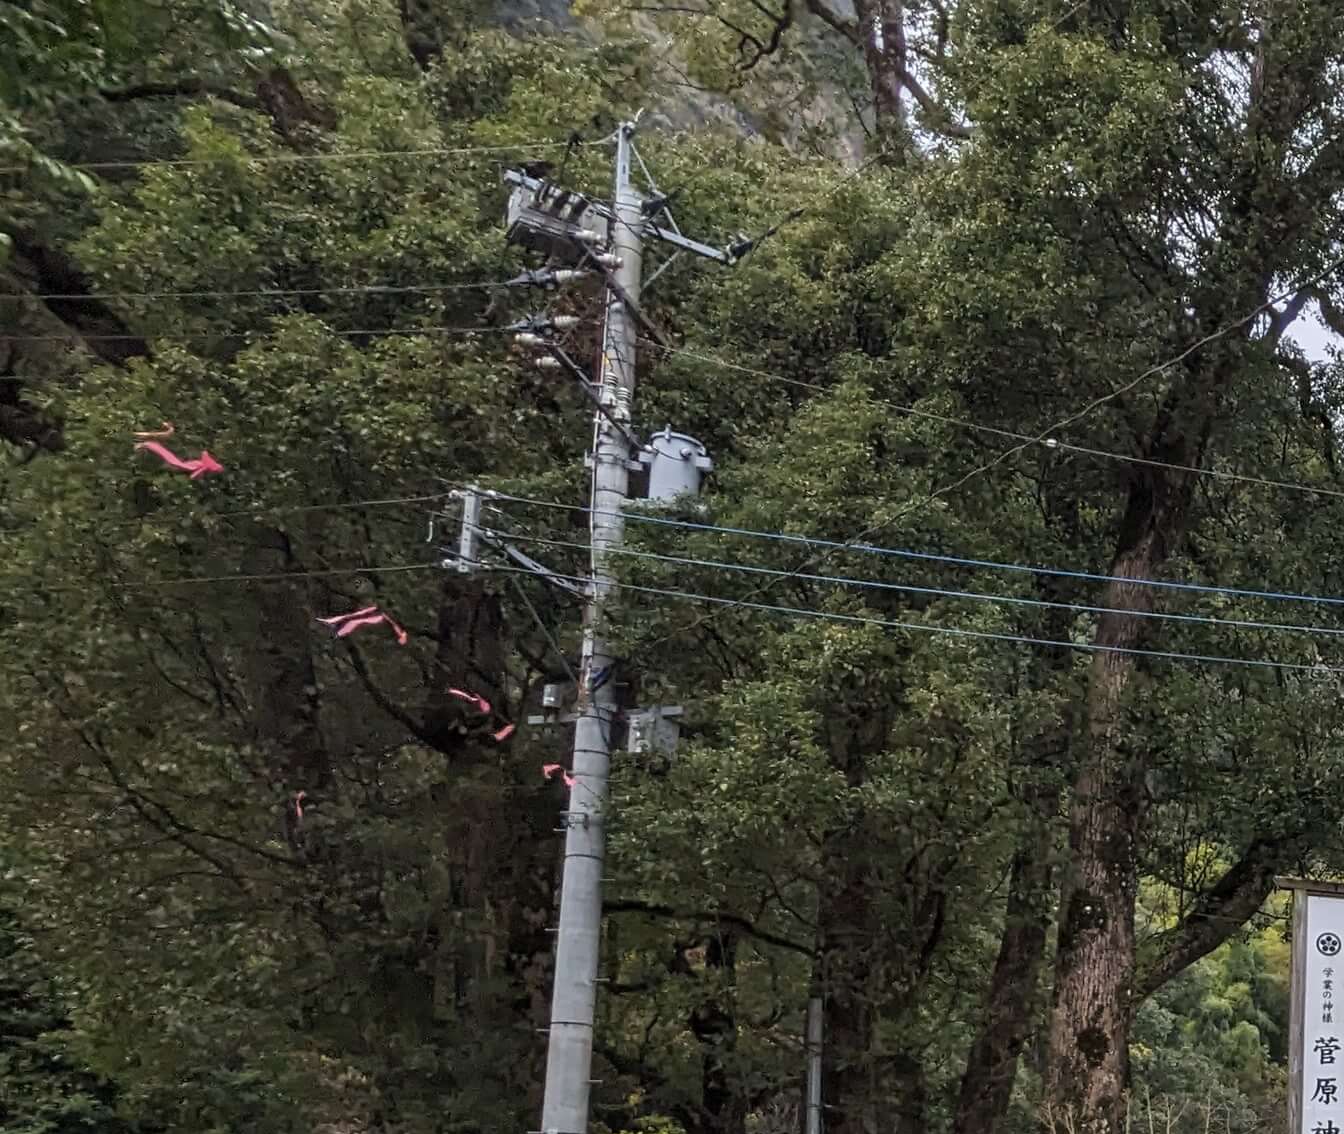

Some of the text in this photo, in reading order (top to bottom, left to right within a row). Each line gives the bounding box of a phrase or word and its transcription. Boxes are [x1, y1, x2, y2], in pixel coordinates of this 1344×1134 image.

[1322, 967, 1334, 1023] 学業の神様
